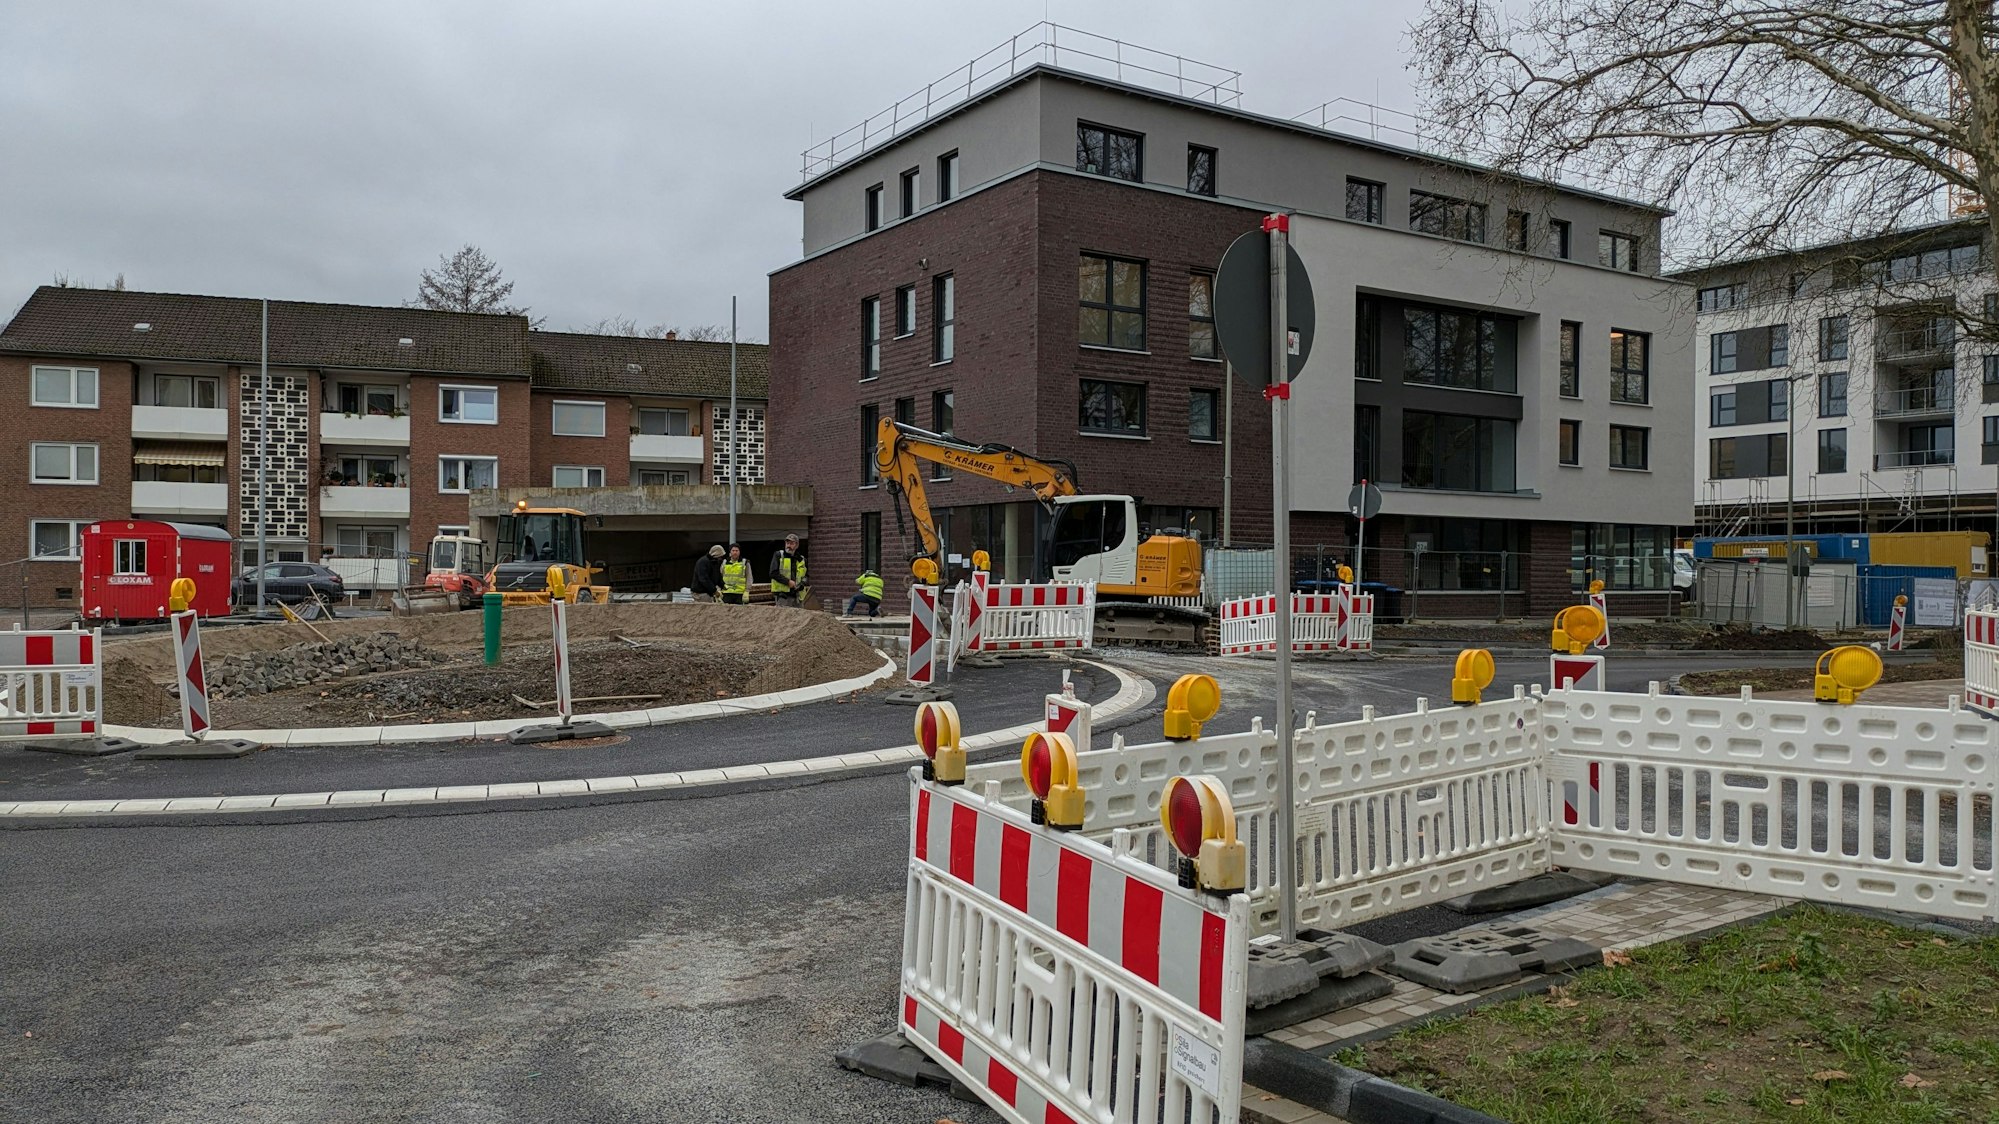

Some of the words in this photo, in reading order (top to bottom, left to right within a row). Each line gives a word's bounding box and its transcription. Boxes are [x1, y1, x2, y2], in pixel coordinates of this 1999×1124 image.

[955, 455, 995, 472] KRÄMER
[117, 576, 152, 584] LOXAM
[1178, 1035, 1189, 1050] Sila
[1177, 1046, 1206, 1072] Signalbau
